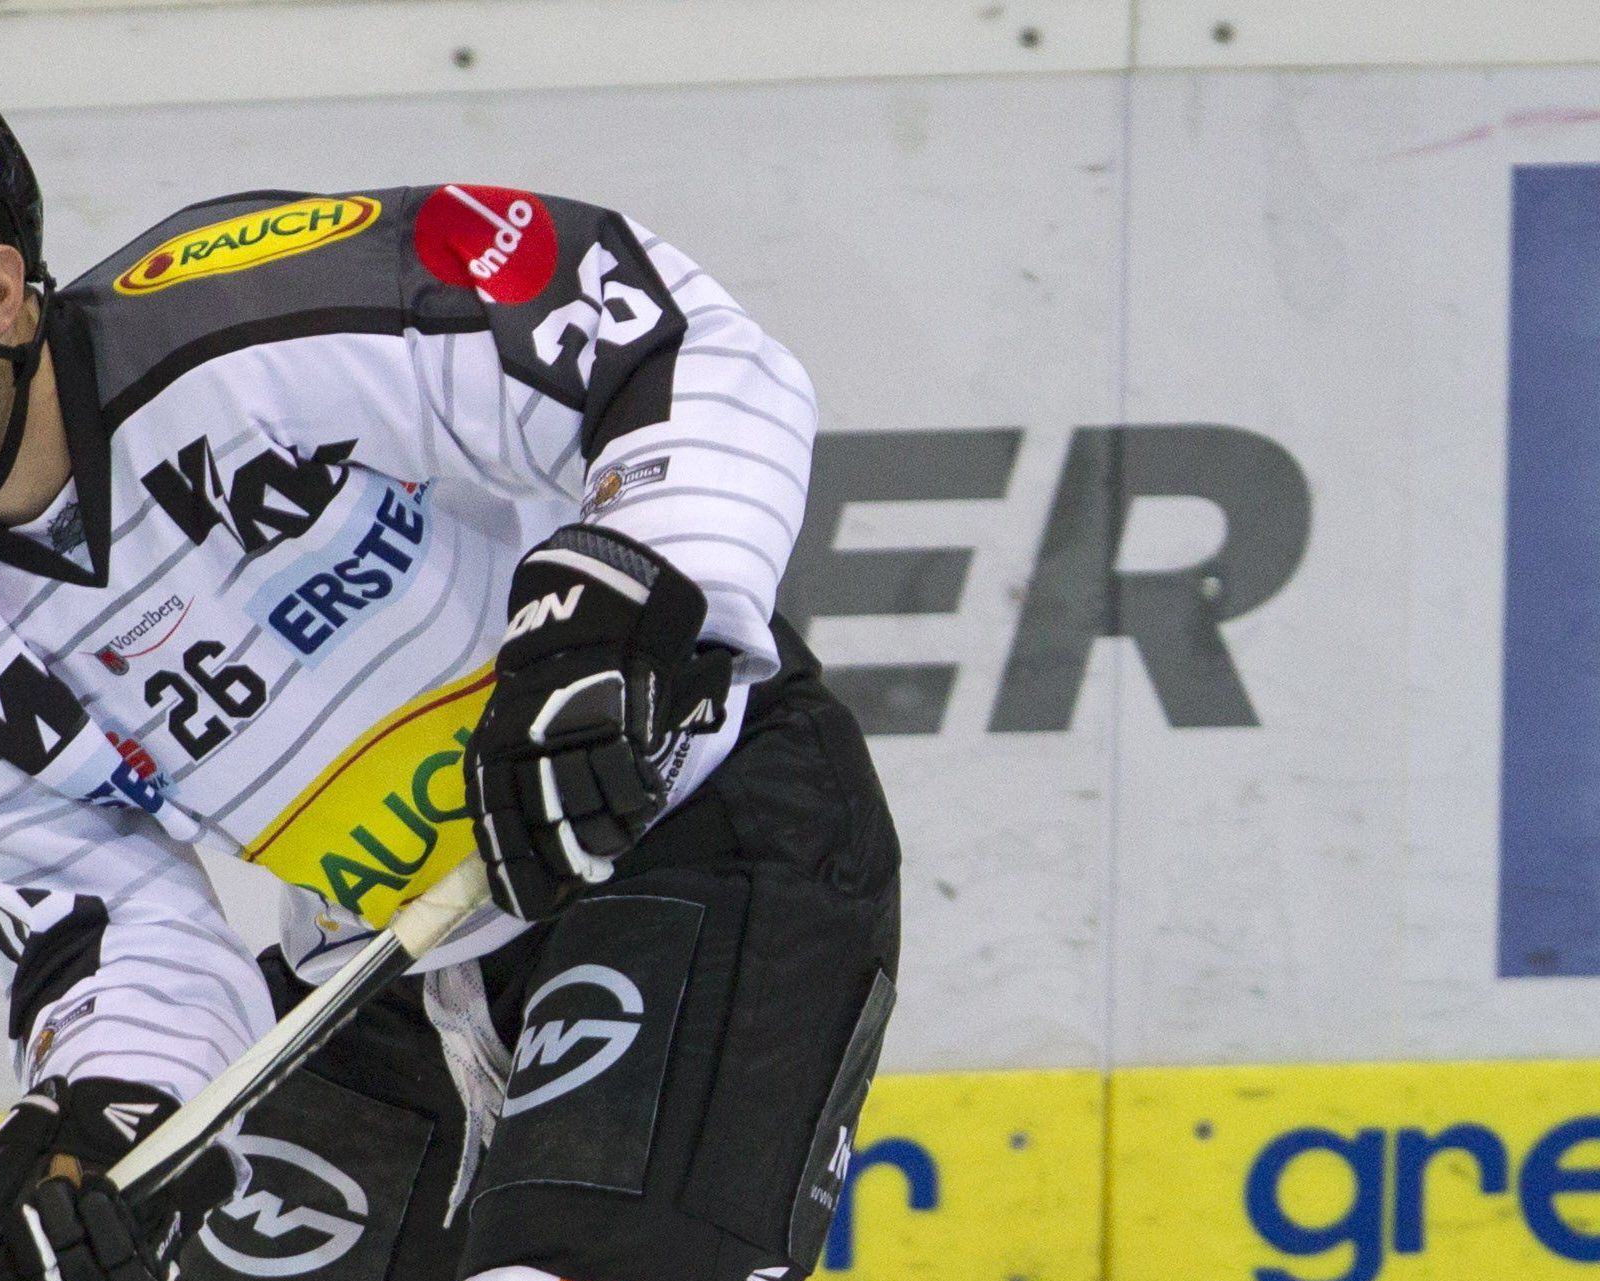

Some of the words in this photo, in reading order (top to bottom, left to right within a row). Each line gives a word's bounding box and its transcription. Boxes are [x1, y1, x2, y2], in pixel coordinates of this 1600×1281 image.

[180, 204, 344, 265] RAUCH
[531, 240, 663, 391] 26
[109, 593, 185, 651] Vorarlberg
[267, 486, 424, 656] ERSTE
[144, 640, 267, 762] 26
